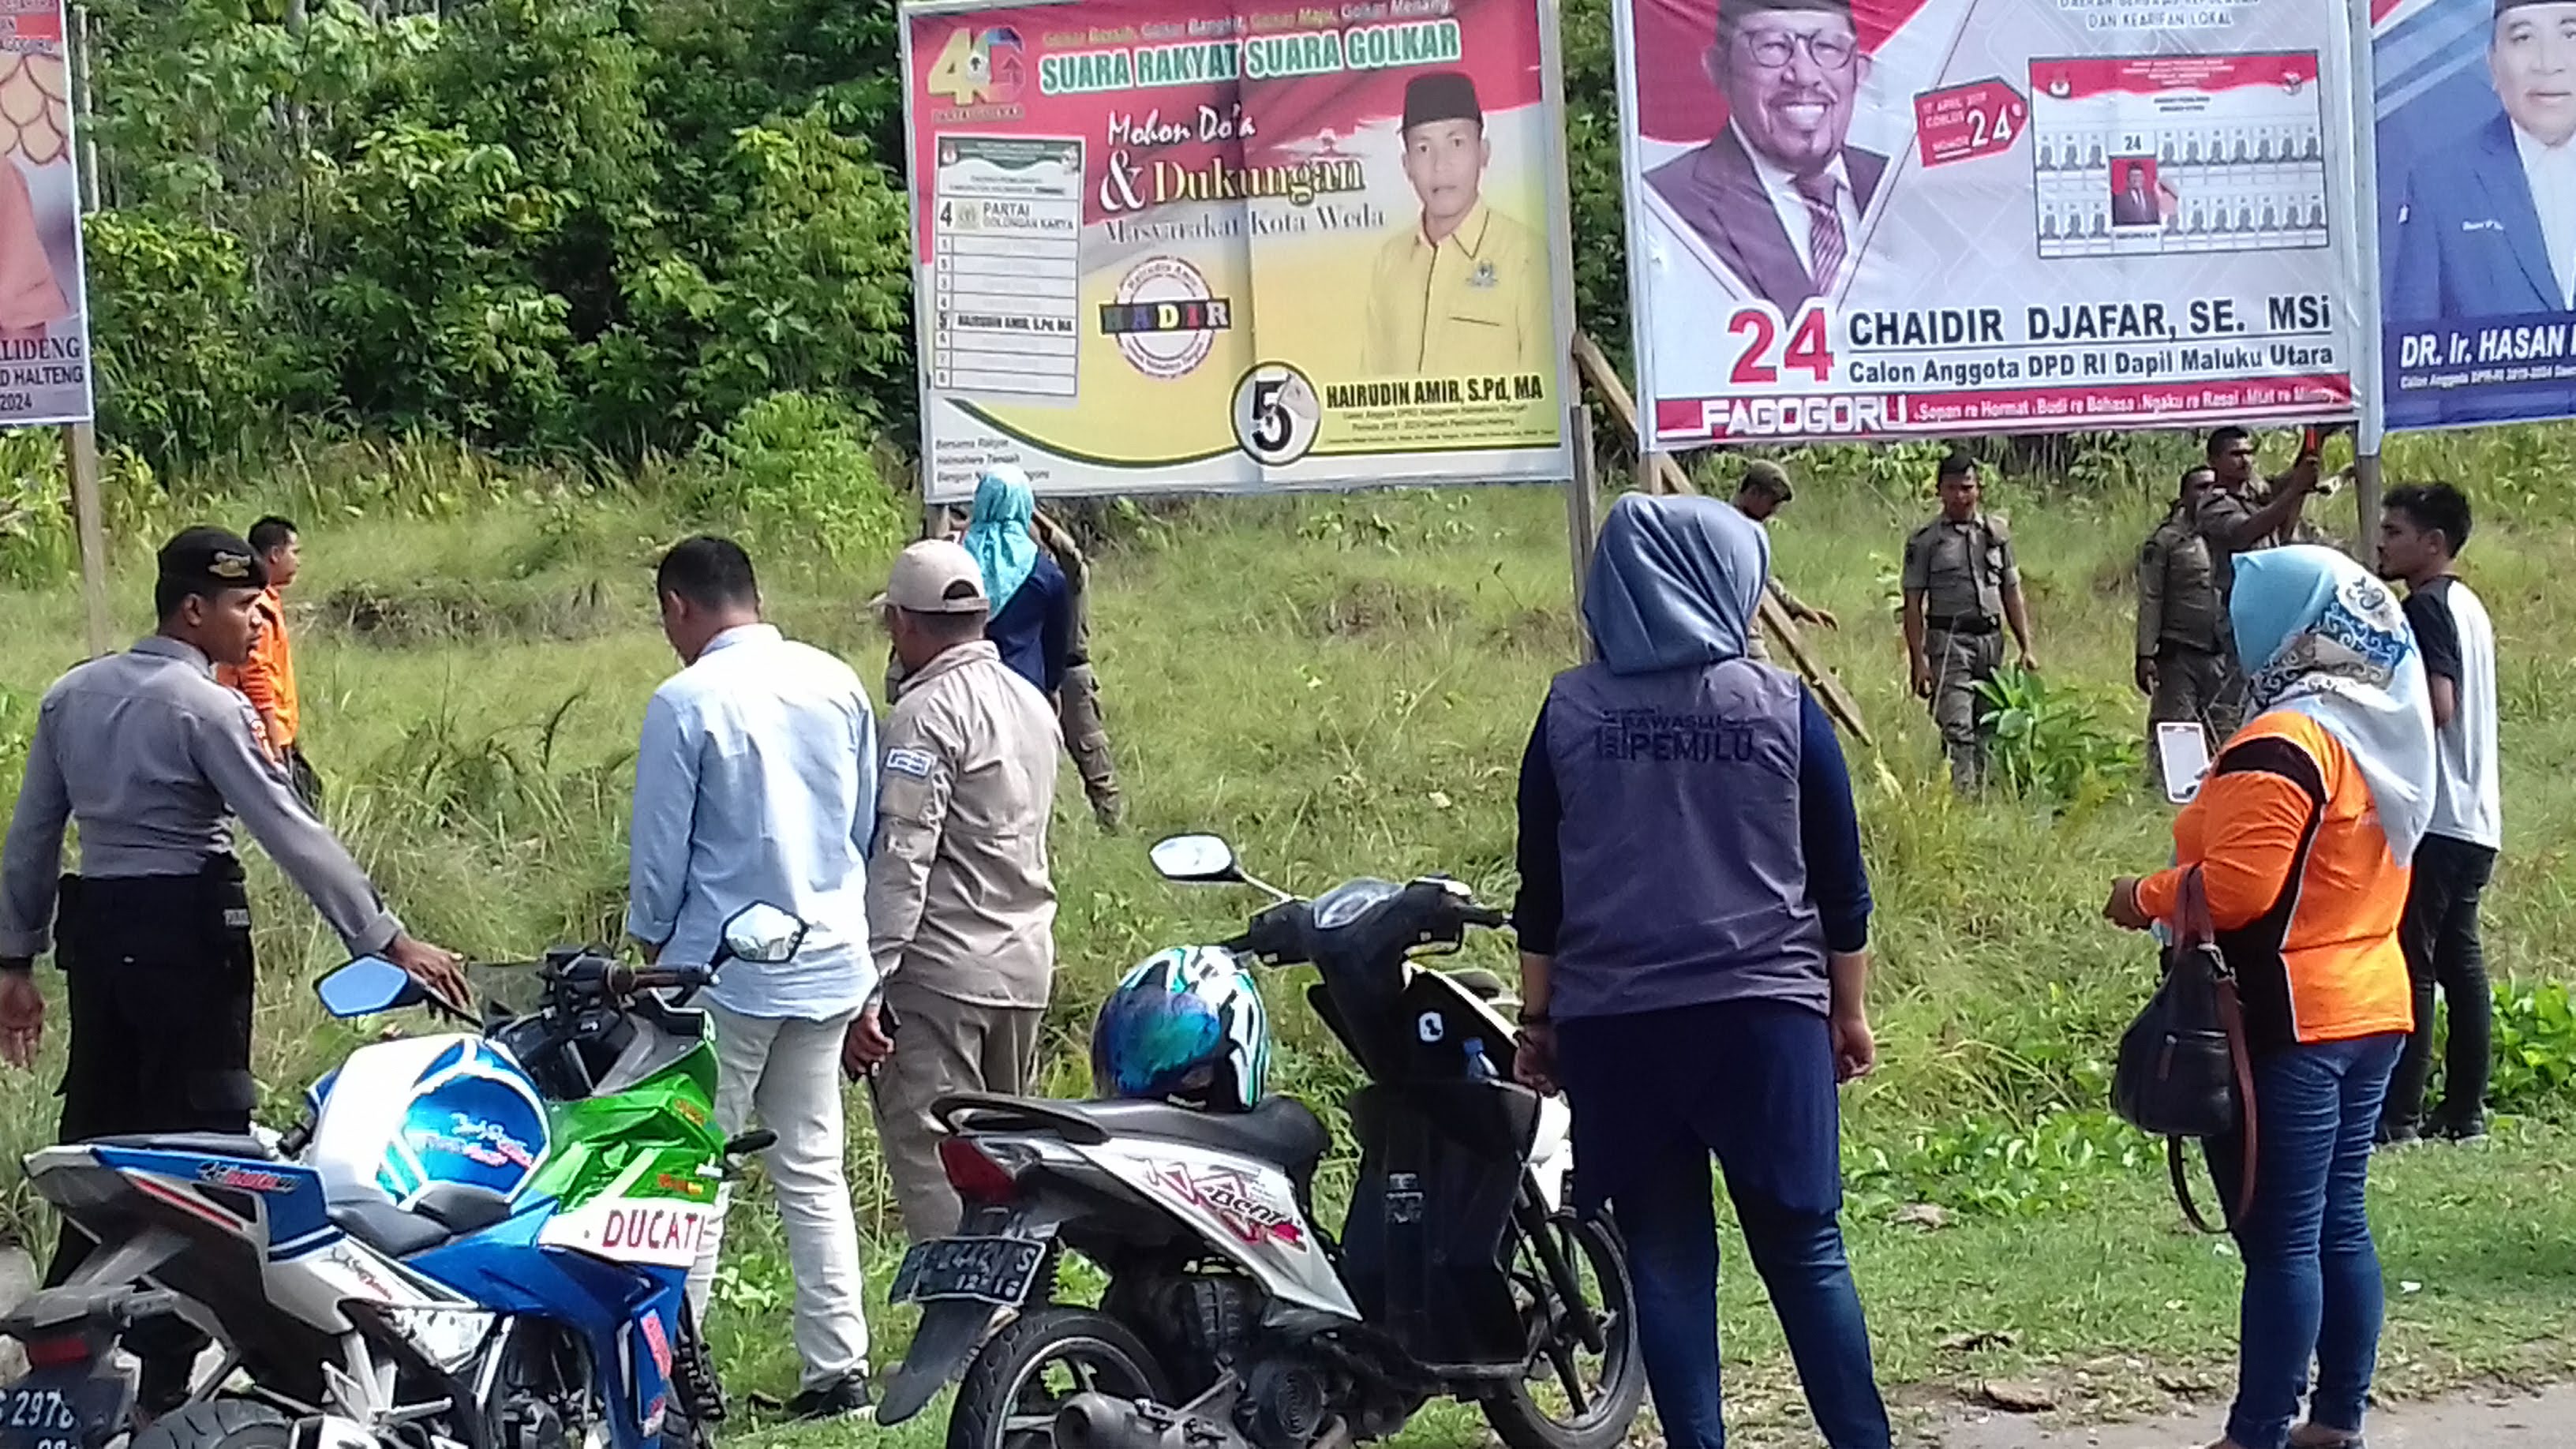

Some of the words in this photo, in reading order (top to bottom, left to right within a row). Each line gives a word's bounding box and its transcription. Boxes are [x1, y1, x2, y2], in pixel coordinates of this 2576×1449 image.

[2088, 13, 2117, 28] DAN
[1041, 51, 1132, 92] SUARA
[1136, 42, 1240, 84] RAKYAT
[1247, 33, 1342, 76] SUARA
[1346, 22, 1459, 66] GOLKAR
[1108, 108, 1192, 146] Mohon
[1967, 104, 2012, 148] 24
[2125, 136, 2142, 151] 24
[1099, 148, 1146, 212] &
[1152, 156, 1368, 207] Dukungan
[939, 200, 953, 227] 4
[983, 202, 1031, 217] PARTAI
[1250, 210, 1309, 235] Kota
[1316, 203, 1388, 230] Weda
[1849, 308, 2005, 346] CHAIDIR
[2027, 302, 2177, 343] DJAFAR,
[2189, 299, 2246, 334] SE.
[2268, 294, 2331, 331] MSi
[0, 337, 80, 361] LIDENG
[1728, 307, 1835, 385] 24
[1848, 360, 1916, 384] Calon
[1923, 357, 2020, 386] Anggota
[2027, 354, 2075, 378] DPD
[2084, 352, 2106, 375] RI
[2115, 350, 2173, 378] Dapil
[2181, 348, 2263, 373] Maluku
[2270, 343, 2334, 366] Utara
[2400, 334, 2444, 368] DR.
[2449, 331, 2473, 365] Ir.
[2477, 324, 2566, 363] HASAN
[14, 366, 84, 386] HALTENG
[1327, 382, 1410, 409] HAIRUDIN
[1413, 379, 1465, 405] AMIR,
[1514, 375, 1544, 399] MA
[0, 393, 33, 411] 2024
[1252, 380, 1293, 453] 5
[1702, 394, 1908, 434] FAGOGORU
[1630, 729, 1754, 762] PEMILU
[602, 1209, 706, 1252] DUCATI
